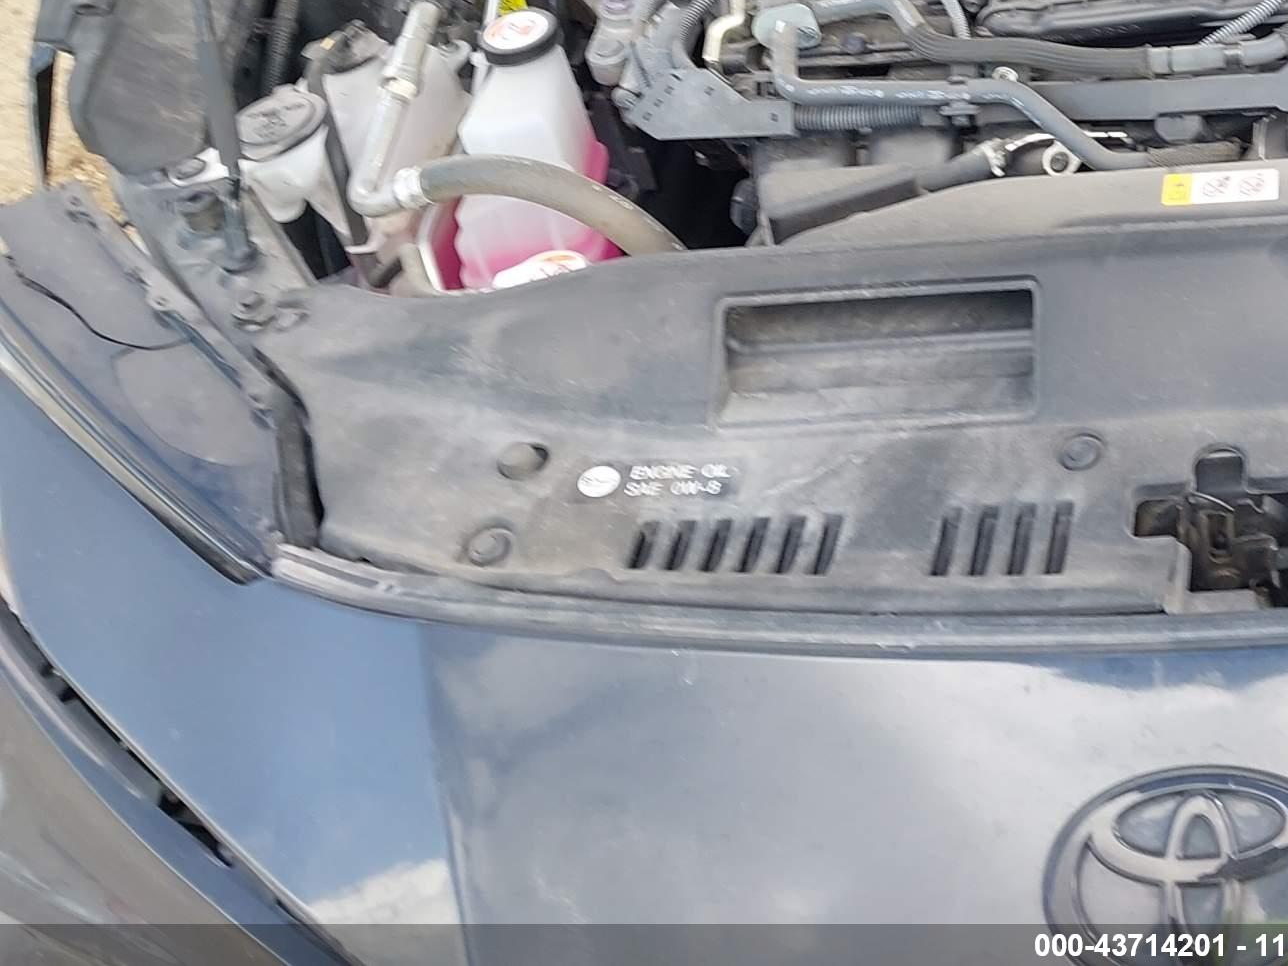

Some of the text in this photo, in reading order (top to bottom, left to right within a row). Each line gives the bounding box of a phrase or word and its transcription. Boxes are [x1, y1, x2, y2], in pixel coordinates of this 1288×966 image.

[629, 463, 731, 480] ENGINE OIL
[623, 480, 664, 497] SAE
